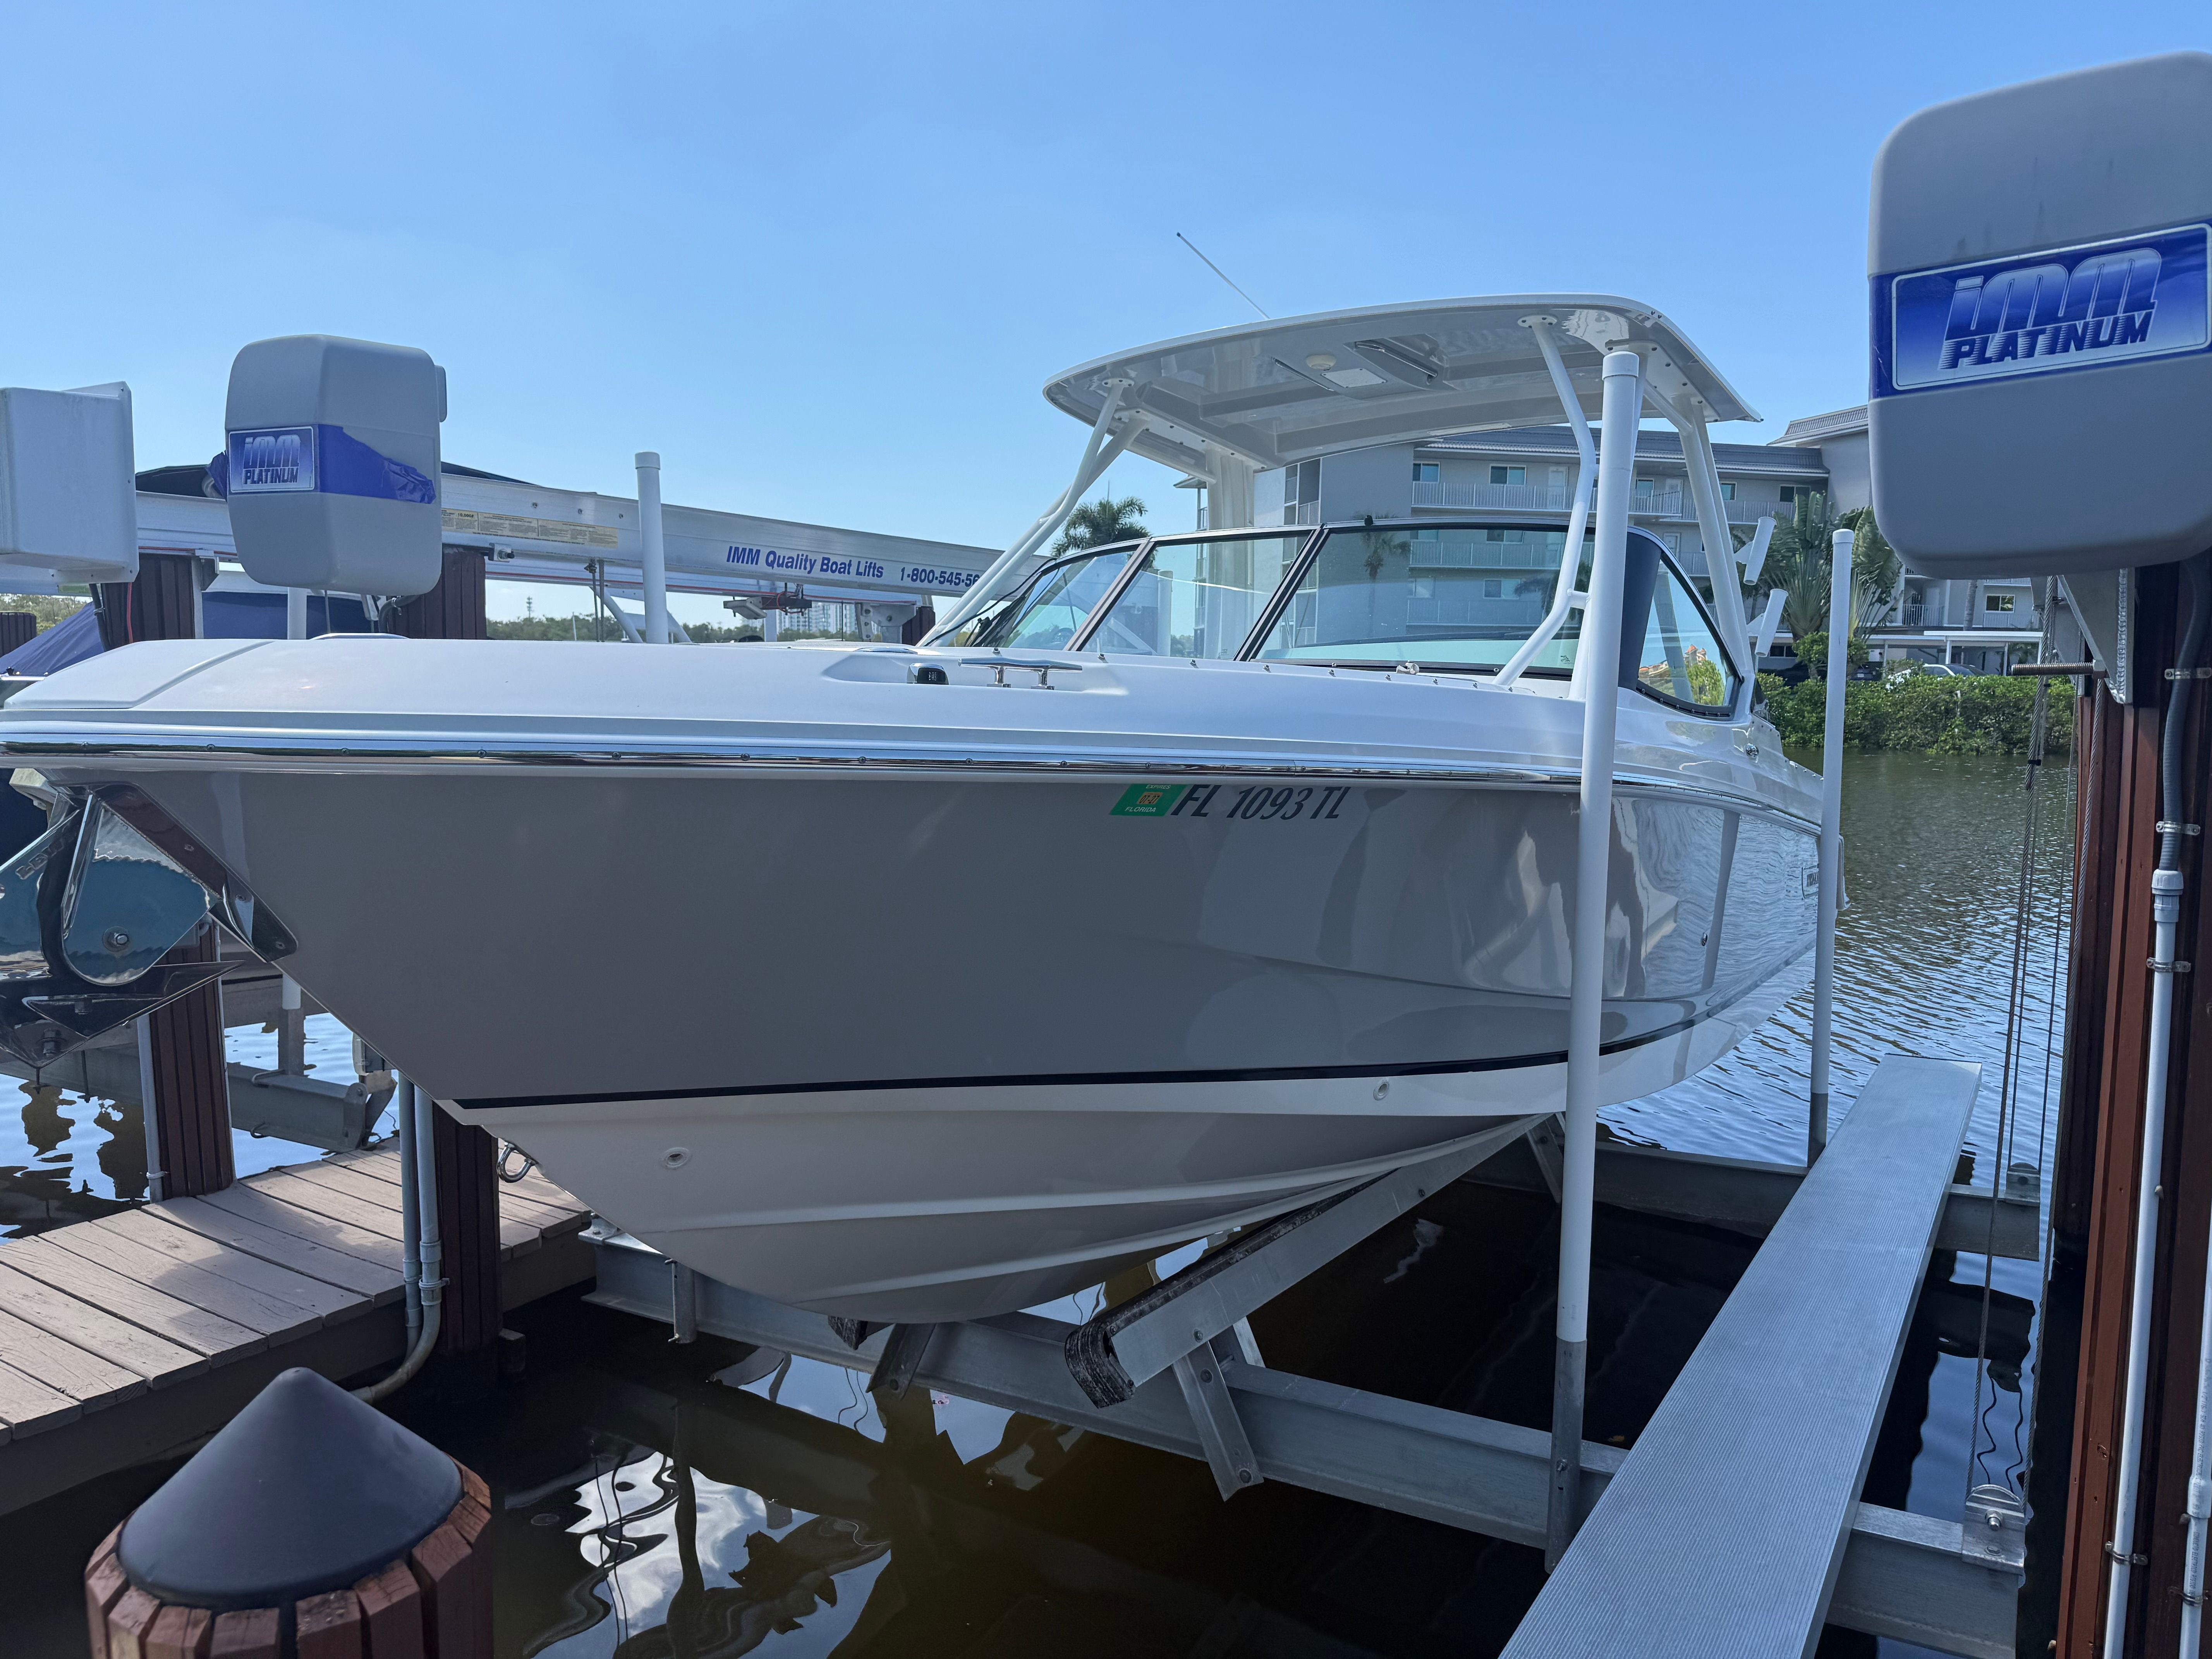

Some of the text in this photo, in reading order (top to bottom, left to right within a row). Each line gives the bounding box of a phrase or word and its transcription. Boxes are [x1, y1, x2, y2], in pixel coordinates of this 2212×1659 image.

[1938, 311, 2155, 370] PLATINUM
[242, 467, 299, 485] PLATINUM
[726, 546, 980, 587] IMM Quality Boat Lifts 1-800-545-56
[1170, 784, 1351, 821] FL 1093 TL
